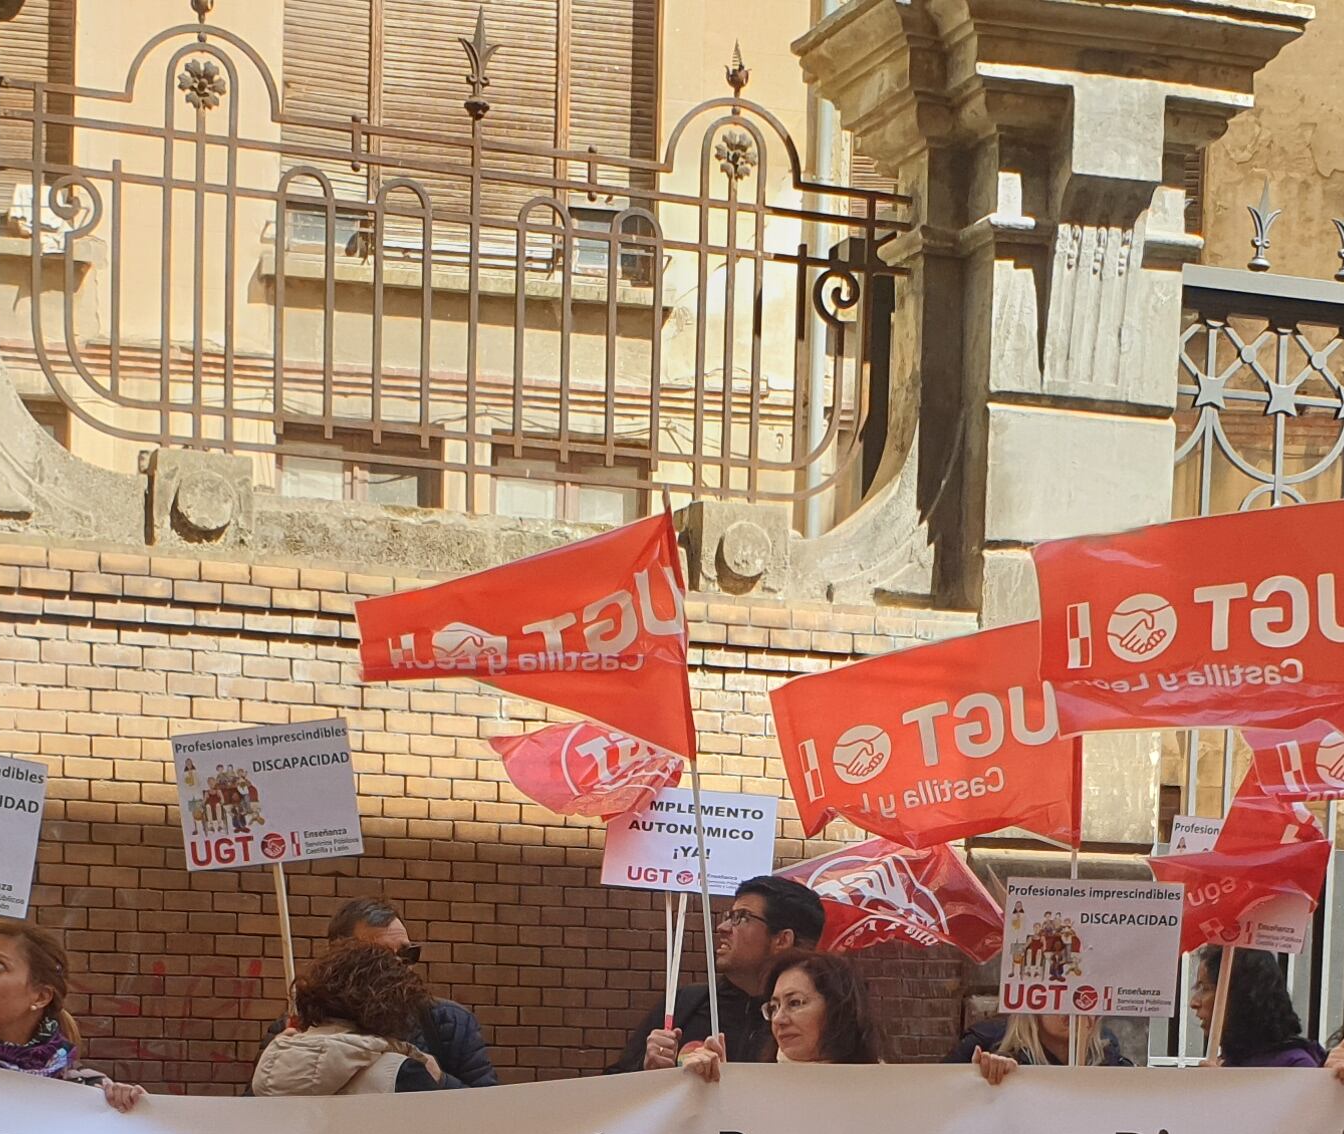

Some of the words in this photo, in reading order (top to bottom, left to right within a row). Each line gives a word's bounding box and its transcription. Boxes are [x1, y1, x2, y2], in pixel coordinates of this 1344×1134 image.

[175, 737, 254, 754] Profesionales
[256, 726, 347, 746] imprescindibles
[252, 751, 350, 773] DISCAPACIDAD
[650, 800, 764, 820] MPLEMENTO
[303, 826, 347, 839] Enseñanza
[1174, 822, 1220, 836] Profesion
[190, 835, 254, 867] UGT
[627, 865, 672, 884] UGT
[1008, 884, 1086, 898] Profesionales
[1089, 887, 1181, 901] imprescindibles
[1080, 912, 1178, 927] DISCAPACIDAD
[1003, 983, 1068, 1011] UGT
[1117, 986, 1161, 996] Enseñanza
